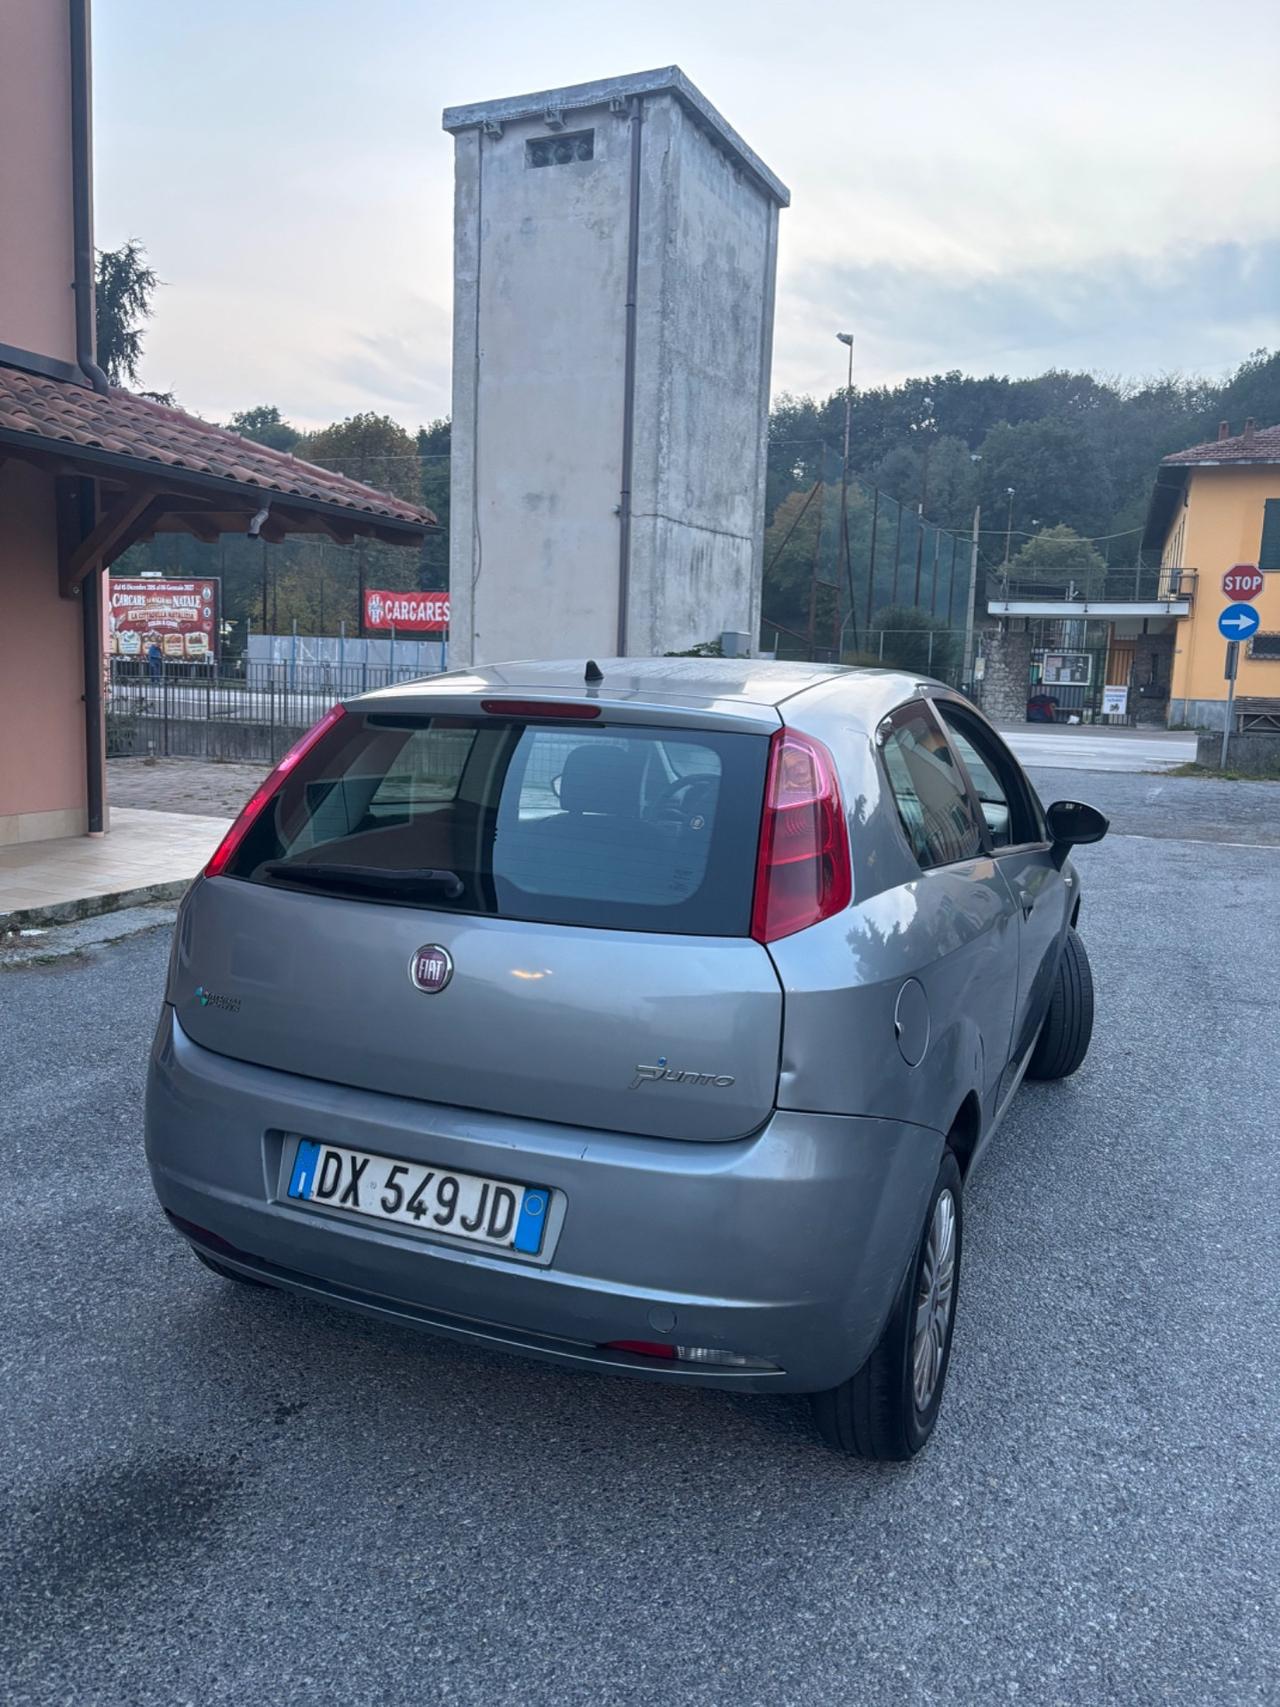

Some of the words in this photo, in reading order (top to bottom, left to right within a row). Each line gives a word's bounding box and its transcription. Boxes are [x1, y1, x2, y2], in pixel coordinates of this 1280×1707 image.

[1224, 576, 1262, 591] STOP
[112, 593, 146, 607] CARCARE
[172, 595, 202, 608] NATALE
[385, 600, 451, 621] CARCARES
[418, 958, 444, 980] FIAT
[316, 1150, 371, 1208] DX
